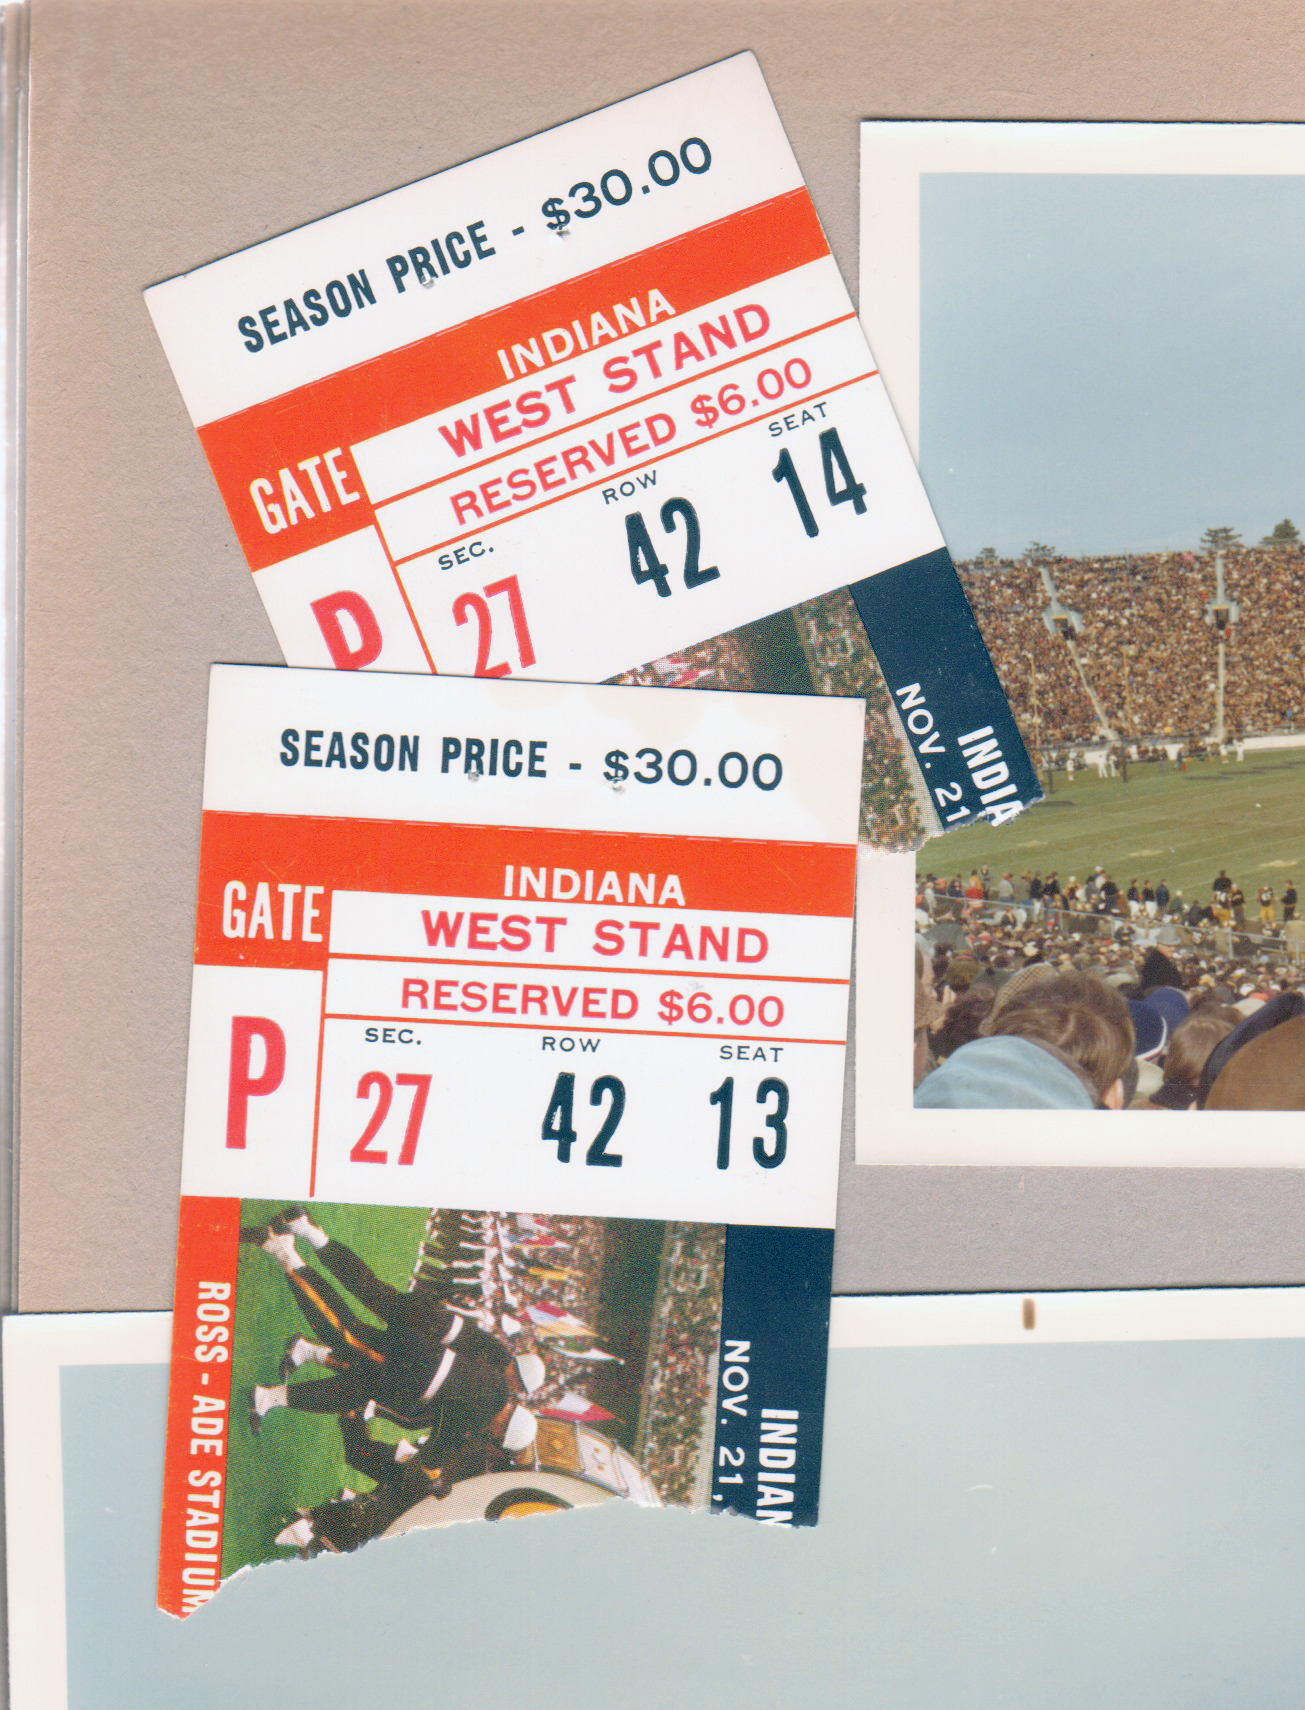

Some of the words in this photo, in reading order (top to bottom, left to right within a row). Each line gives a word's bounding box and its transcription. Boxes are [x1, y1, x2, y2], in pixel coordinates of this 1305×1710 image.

[238, 269, 376, 353] SEASON
[386, 220, 496, 293] PRICE
[541, 137, 712, 236] $30.00
[497, 288, 676, 380] INDIANA
[438, 374, 577, 457] WEST
[603, 303, 771, 393] STAND
[769, 402, 826, 437] SEAT
[450, 413, 677, 525] RESERVED
[690, 357, 812, 429] $6.00
[772, 427, 867, 538] 14
[251, 447, 360, 534] GATE
[602, 470, 656, 504] ROW
[438, 541, 494, 570] SEC.
[625, 497, 720, 598] 42
[452, 575, 536, 679] 27
[280, 728, 419, 772] SEASON
[441, 737, 547, 778] PRICE
[603, 748, 783, 791] $30.00
[895, 682, 946, 769] NOV.
[934, 781, 971, 822] 21
[957, 725, 1025, 827] INDIA
[222, 881, 325, 942] GATE
[504, 865, 685, 906] INDIANA
[421, 910, 566, 953] WEST
[592, 919, 769, 963] STAND
[365, 1027, 423, 1044] SEC.
[401, 978, 639, 1020] RESERVED
[657, 989, 784, 1027] $6.00
[542, 1037, 600, 1052] ROW
[226, 1015, 286, 1150] P
[720, 1045, 783, 1062] SEAT
[349, 1071, 432, 1166] 27
[542, 1072, 626, 1168] 42
[710, 1077, 789, 1170] 13
[195, 1282, 230, 1363] ROSS
[721, 1340, 750, 1424] NOV.
[190, 1395, 225, 1456] ADE
[756, 1408, 800, 1528] INDIAN
[713, 1446, 745, 1502] 21,
